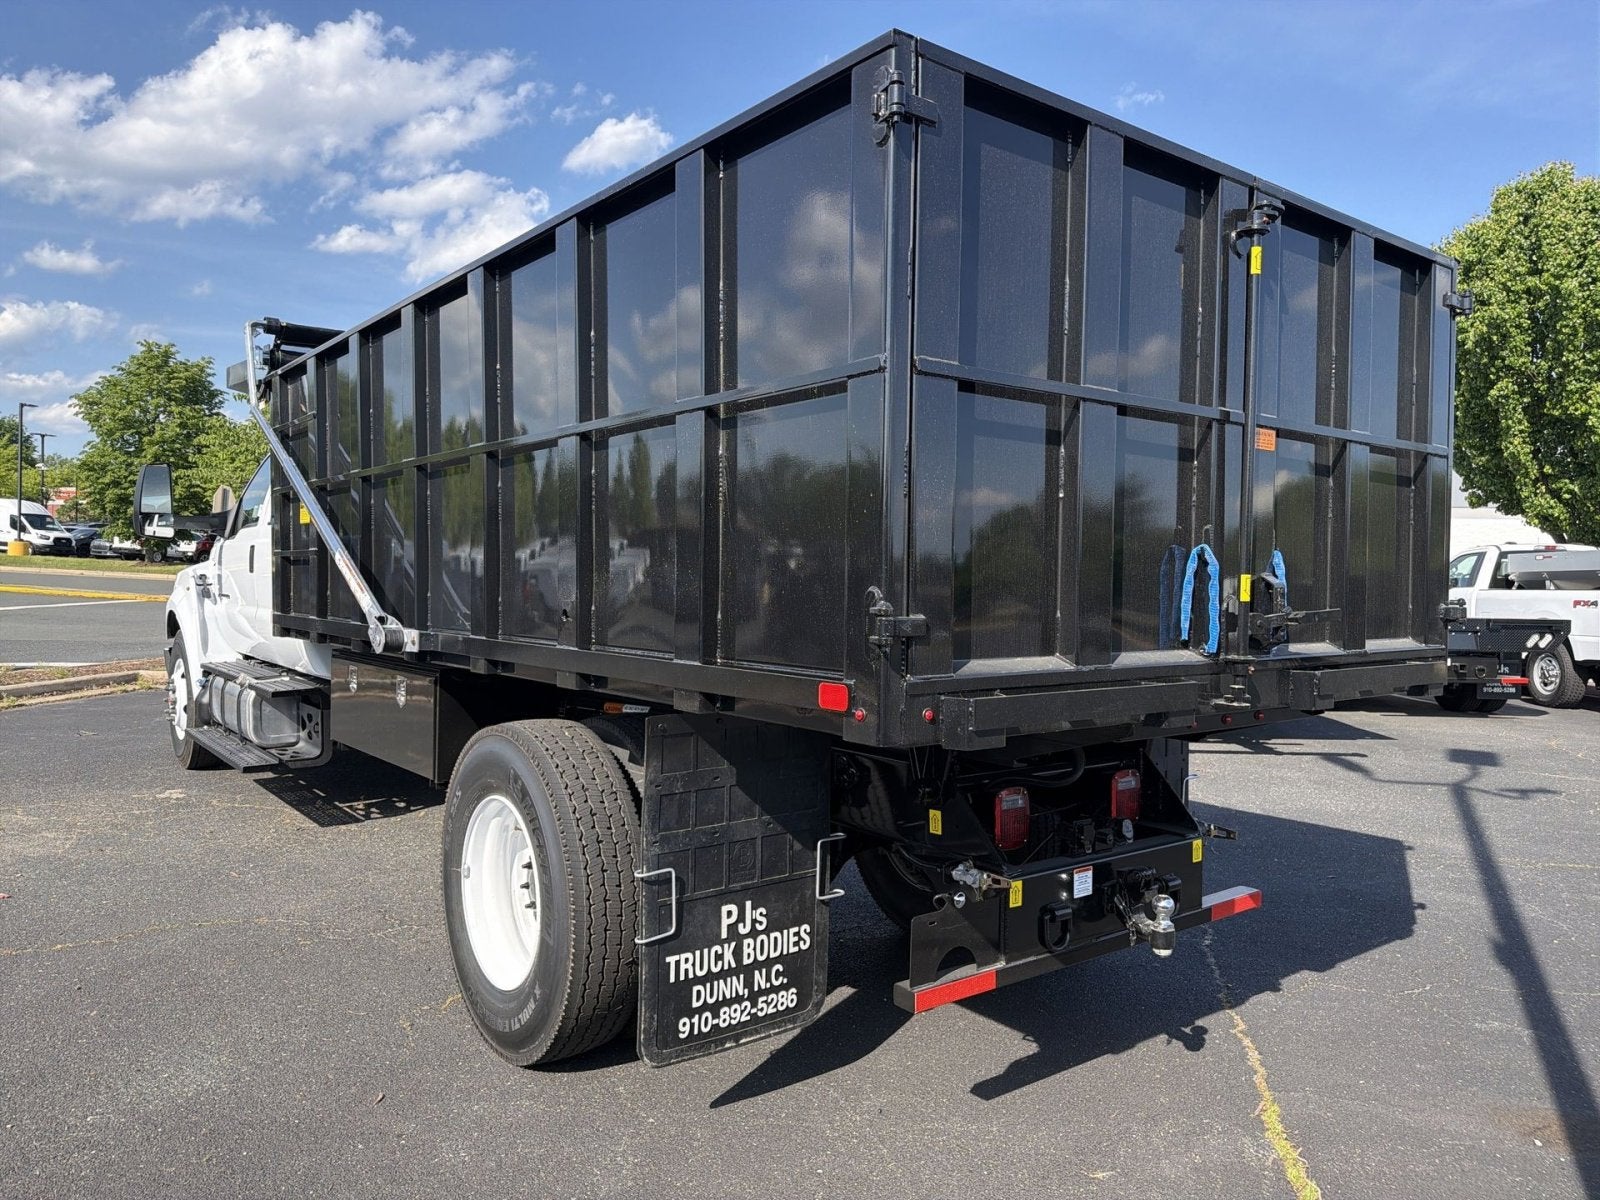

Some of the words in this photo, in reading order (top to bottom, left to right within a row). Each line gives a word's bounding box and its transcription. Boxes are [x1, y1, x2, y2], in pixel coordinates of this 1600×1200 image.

[1572, 600, 1599, 609] FX4
[665, 941, 737, 984] TRUCK
[742, 923, 811, 965] BODIES
[691, 973, 749, 1008] DUNN,
[753, 963, 789, 993] N.C.
[678, 988, 798, 1039] 910-892-5286
